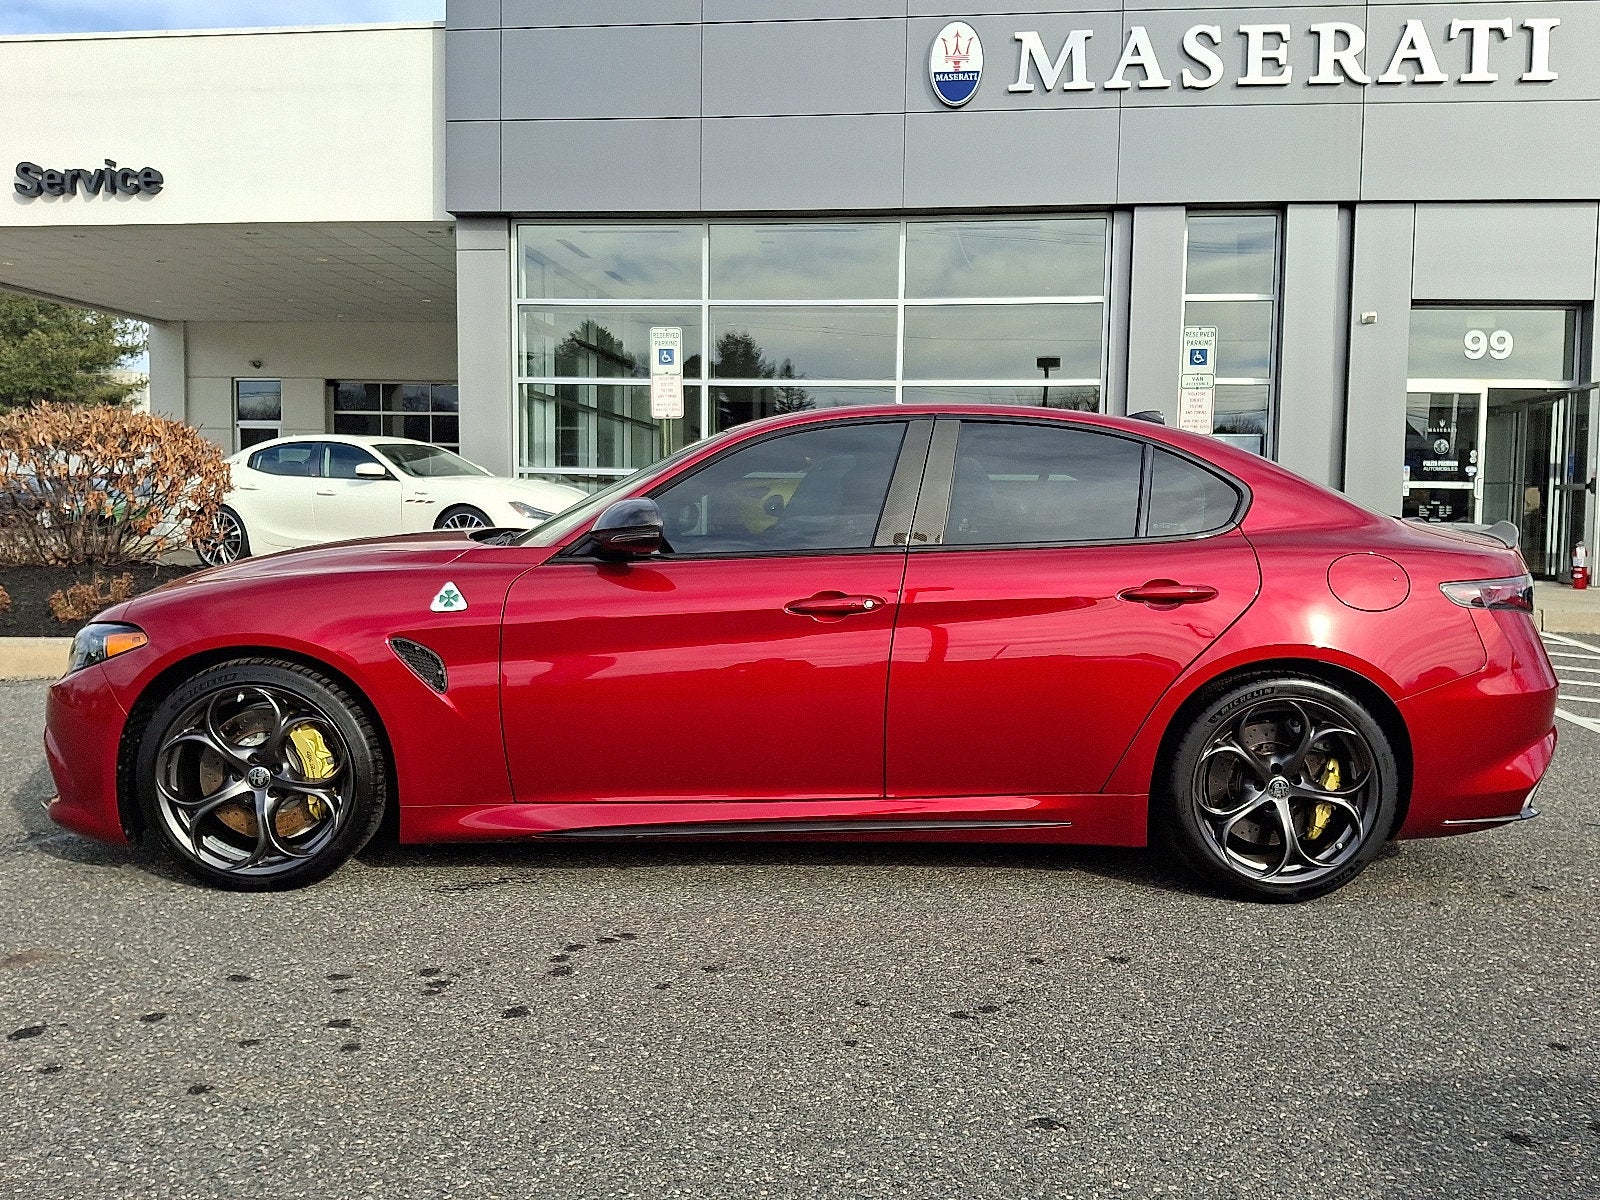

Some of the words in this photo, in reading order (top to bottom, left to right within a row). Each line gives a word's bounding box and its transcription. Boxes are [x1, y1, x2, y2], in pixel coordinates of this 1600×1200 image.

[1008, 18, 1561, 92] MASERATI
[935, 72, 978, 82] MASERATI
[14, 158, 164, 198] Service
[1186, 339, 1213, 347] PARKING
[1464, 329, 1514, 360] 99
[1221, 687, 1273, 715] MICHELIN
